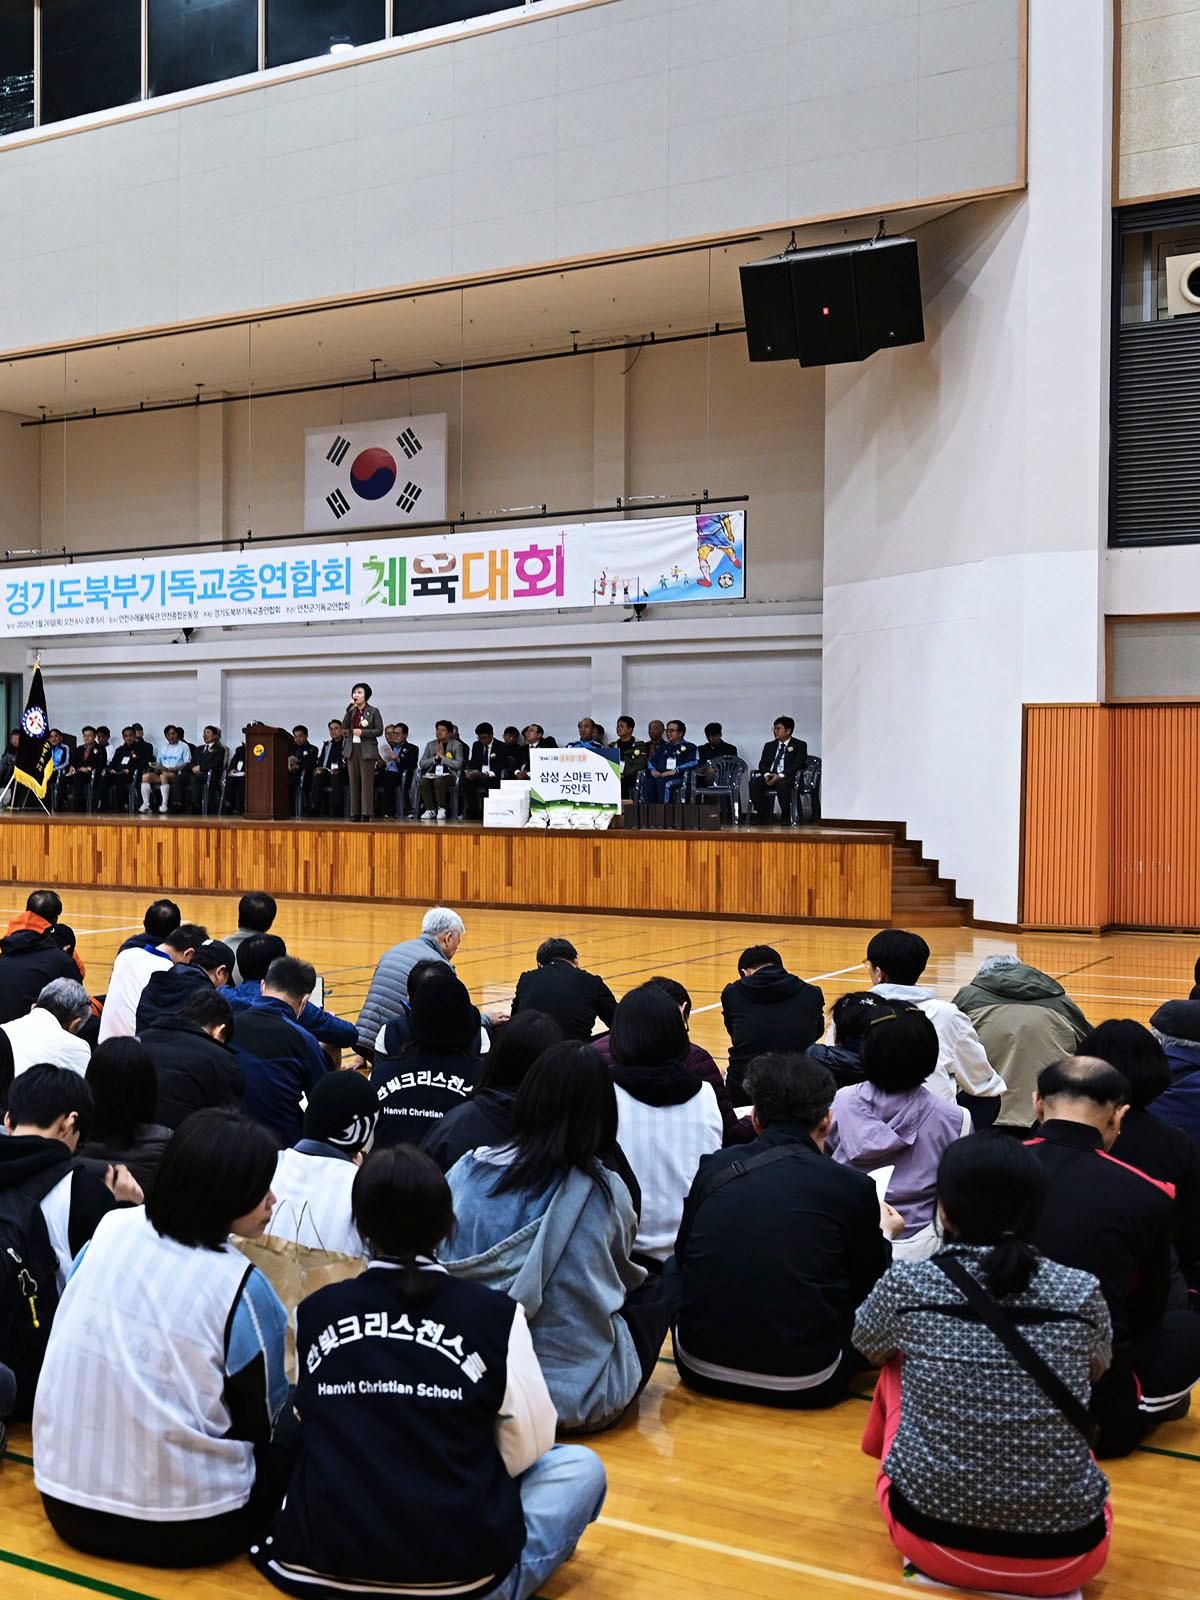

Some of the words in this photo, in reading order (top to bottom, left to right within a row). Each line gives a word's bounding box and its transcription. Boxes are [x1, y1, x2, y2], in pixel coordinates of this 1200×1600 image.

[5, 556, 351, 616] 경기도북부기독교총연합회
[362, 543, 565, 607] 체육대회
[539, 771, 560, 783] 삼성
[562, 772, 593, 783] 스마트
[595, 772, 609, 782] TV
[559, 784, 591, 795] 75인치
[383, 1106, 408, 1116] Hanvit
[409, 1107, 444, 1119] Christian
[317, 1381, 356, 1396] Hanvit
[358, 1380, 414, 1396] Christian
[416, 1383, 463, 1401] School
